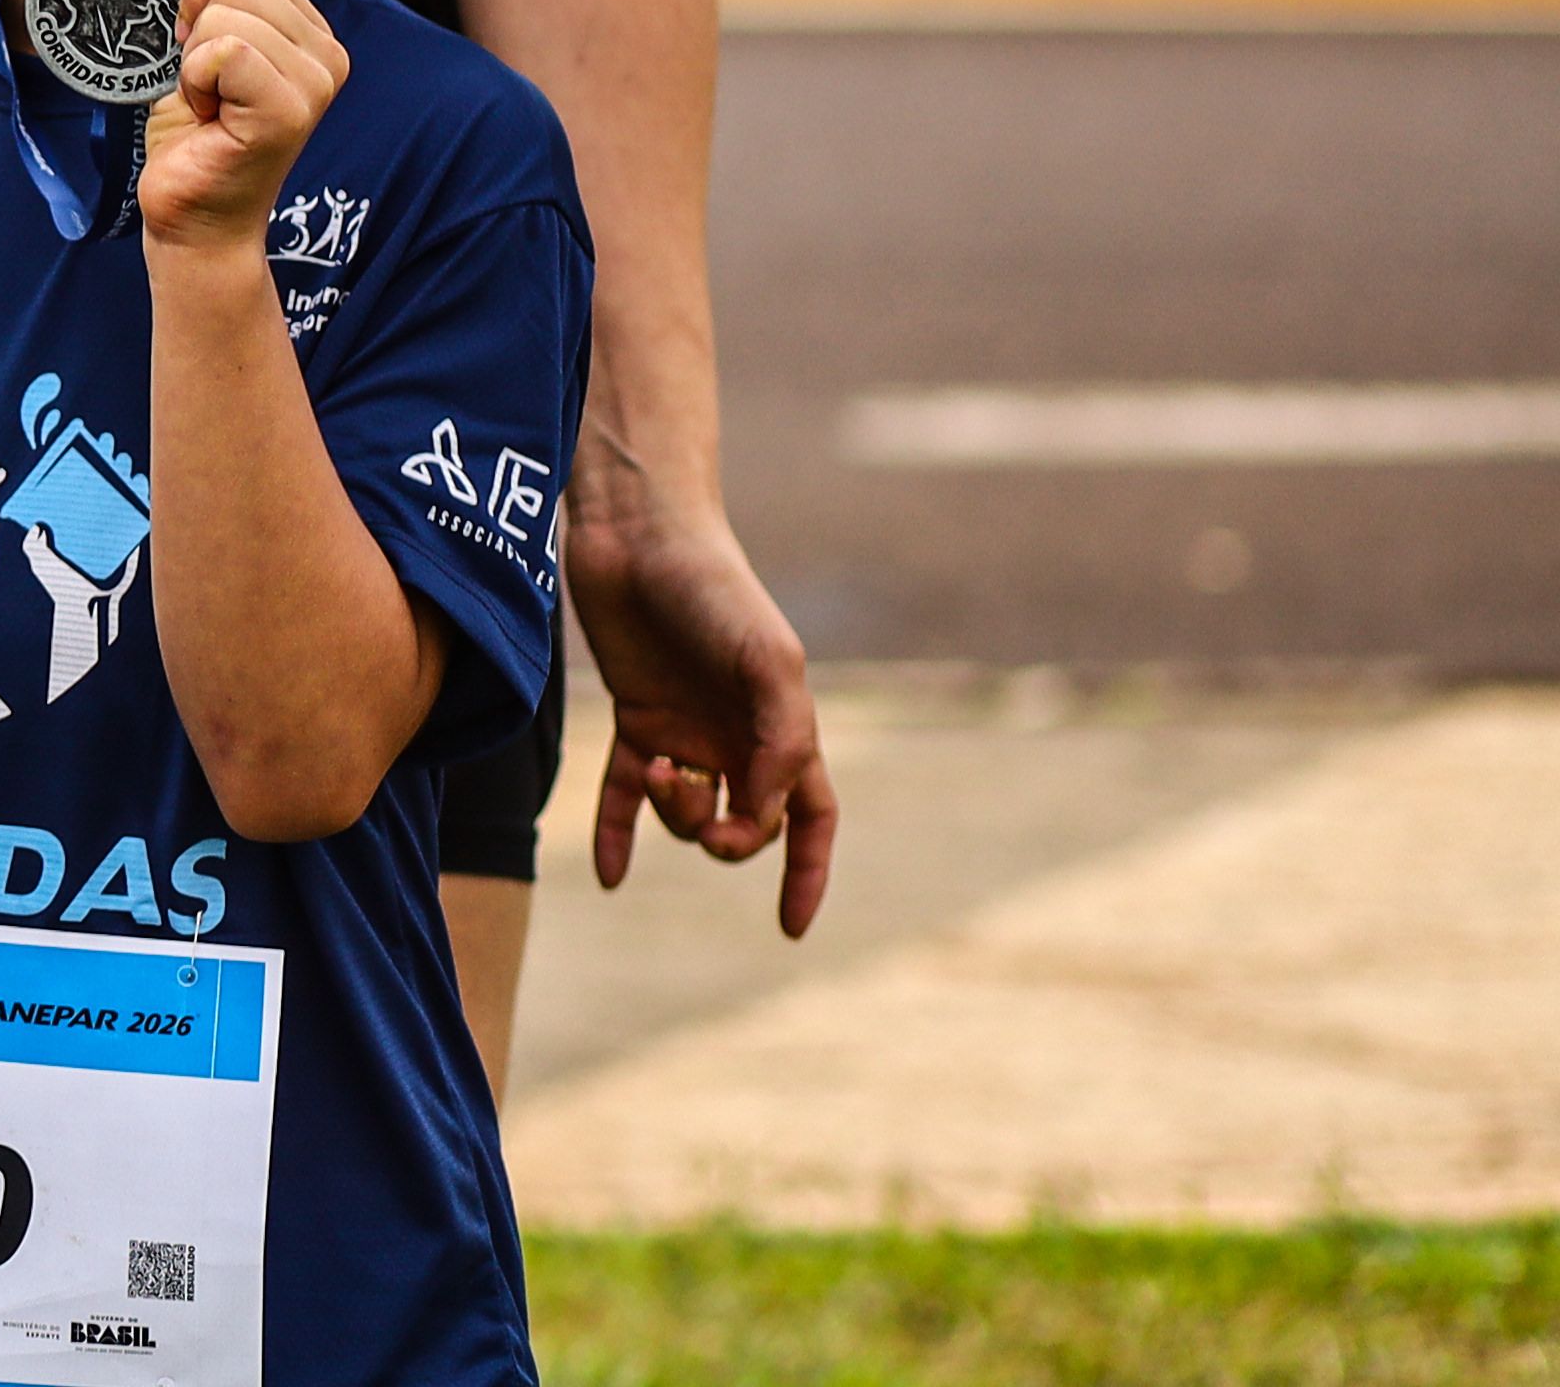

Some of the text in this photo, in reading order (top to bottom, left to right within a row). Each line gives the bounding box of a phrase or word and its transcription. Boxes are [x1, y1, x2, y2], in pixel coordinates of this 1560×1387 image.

[36, 16, 118, 92] CORRIDAS
[126, 1011, 193, 1037] 2026
[187, 1245, 196, 1302] RESULTADO
[71, 1321, 156, 1348] BRASIL
